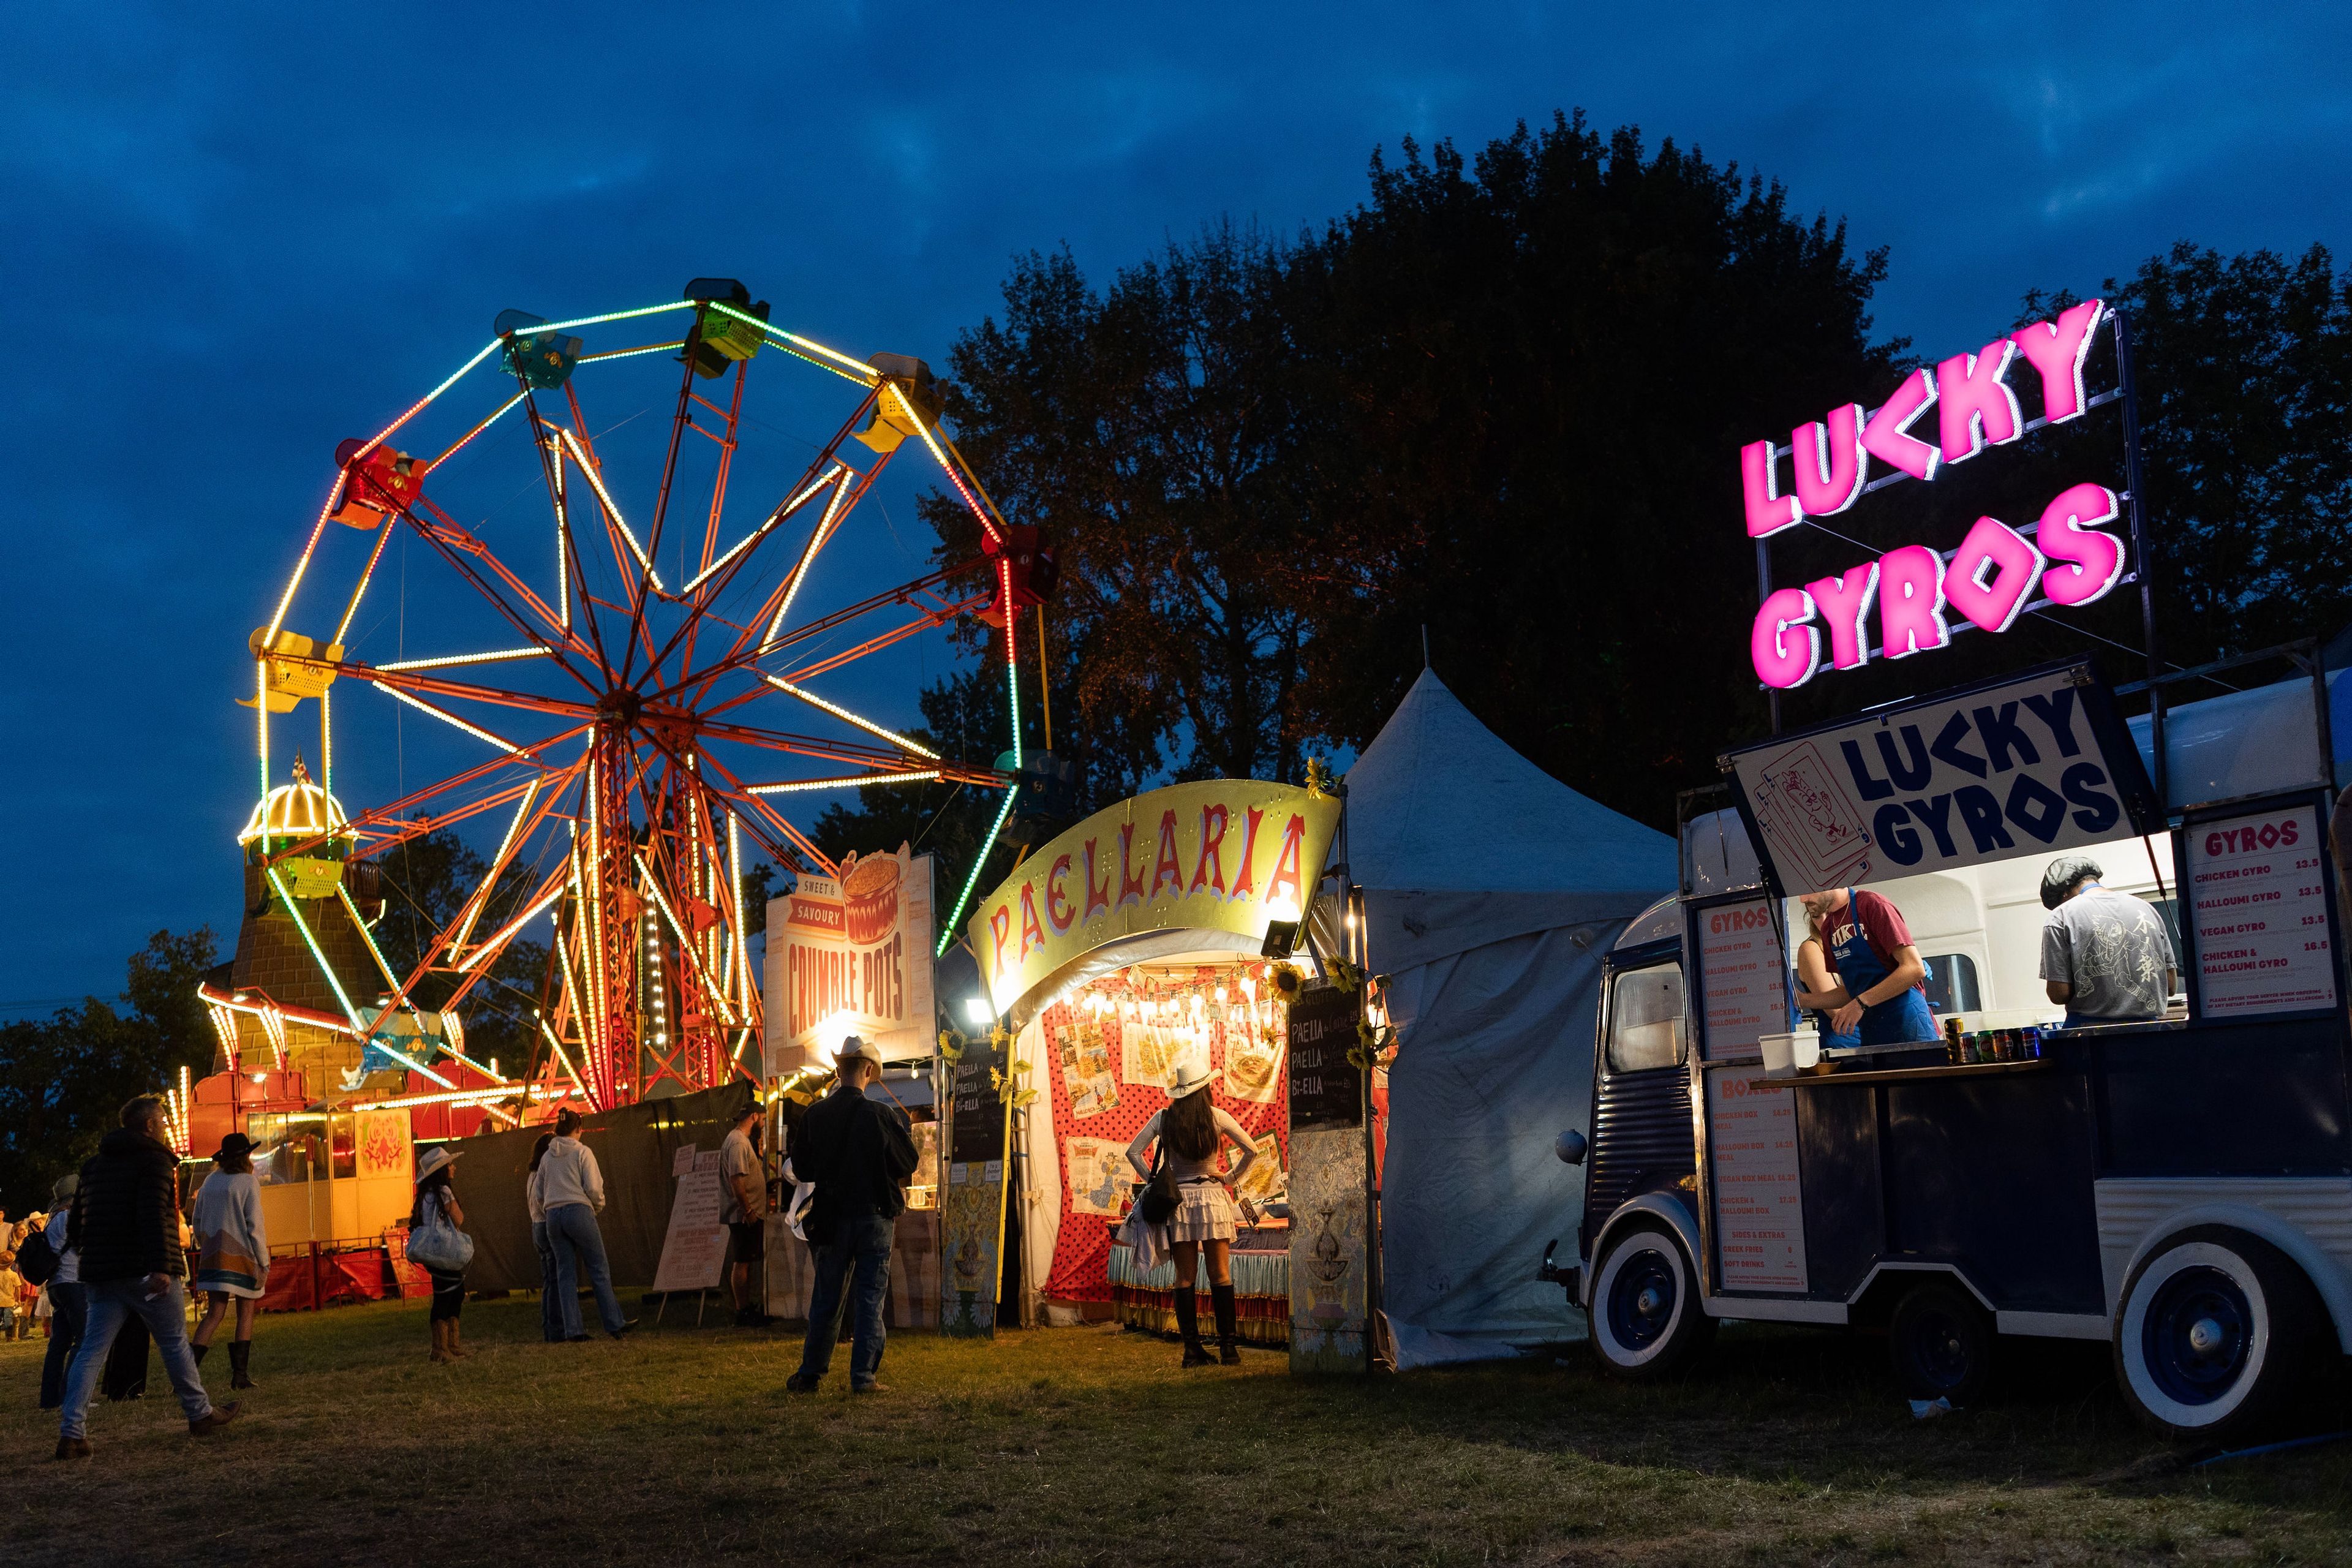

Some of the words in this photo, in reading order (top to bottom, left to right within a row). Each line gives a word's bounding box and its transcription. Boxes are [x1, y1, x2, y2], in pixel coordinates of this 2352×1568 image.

[1741, 298, 2105, 538] LUCKY
[1752, 483, 2125, 688] GYROS
[1839, 686, 2081, 801] LUCKY
[1873, 762, 2120, 866] GYROS
[2206, 820, 2299, 856] GYROS
[2195, 870, 2239, 882] CHICKEN
[2242, 865, 2271, 876] GYRO
[2296, 859, 2319, 869] 13.5
[804, 880, 829, 895] SWEET
[830, 884, 835, 895] &
[988, 803, 1305, 975] PAELLARIA
[2198, 895, 2249, 909] HALLOUMI
[2252, 892, 2281, 902] GYRO
[2299, 886, 2321, 896] 13.5
[798, 905, 840, 925] SAVOURY
[1711, 907, 1768, 934] GYROS
[2199, 925, 2234, 937] VEGAN
[2237, 922, 2266, 932] GYRO
[2302, 915, 2324, 925] 13.5
[1704, 944, 1732, 954] CHICKEN
[1733, 941, 1751, 950] GYRO
[2202, 949, 2247, 961] CHICKEN
[2304, 941, 2328, 951] 16.5
[1705, 965, 1738, 976] HALLOUMI
[2203, 961, 2256, 974] HALLOUMI
[2259, 959, 2288, 968] GYRO
[789, 943, 857, 1039] CRUMBLE
[864, 931, 903, 1021] POTS
[1706, 989, 1727, 998] VEGAN
[1708, 1009, 1736, 1017] CHICKEN
[1709, 1018, 1741, 1027] HALLOUMI
[1743, 1016, 1760, 1024] GYRO
[1292, 1019, 1323, 1044] PAELLA
[1292, 1047, 1322, 1071] PAELLA
[957, 1063, 978, 1079] PAELLA
[956, 1082, 978, 1095] PAELLA
